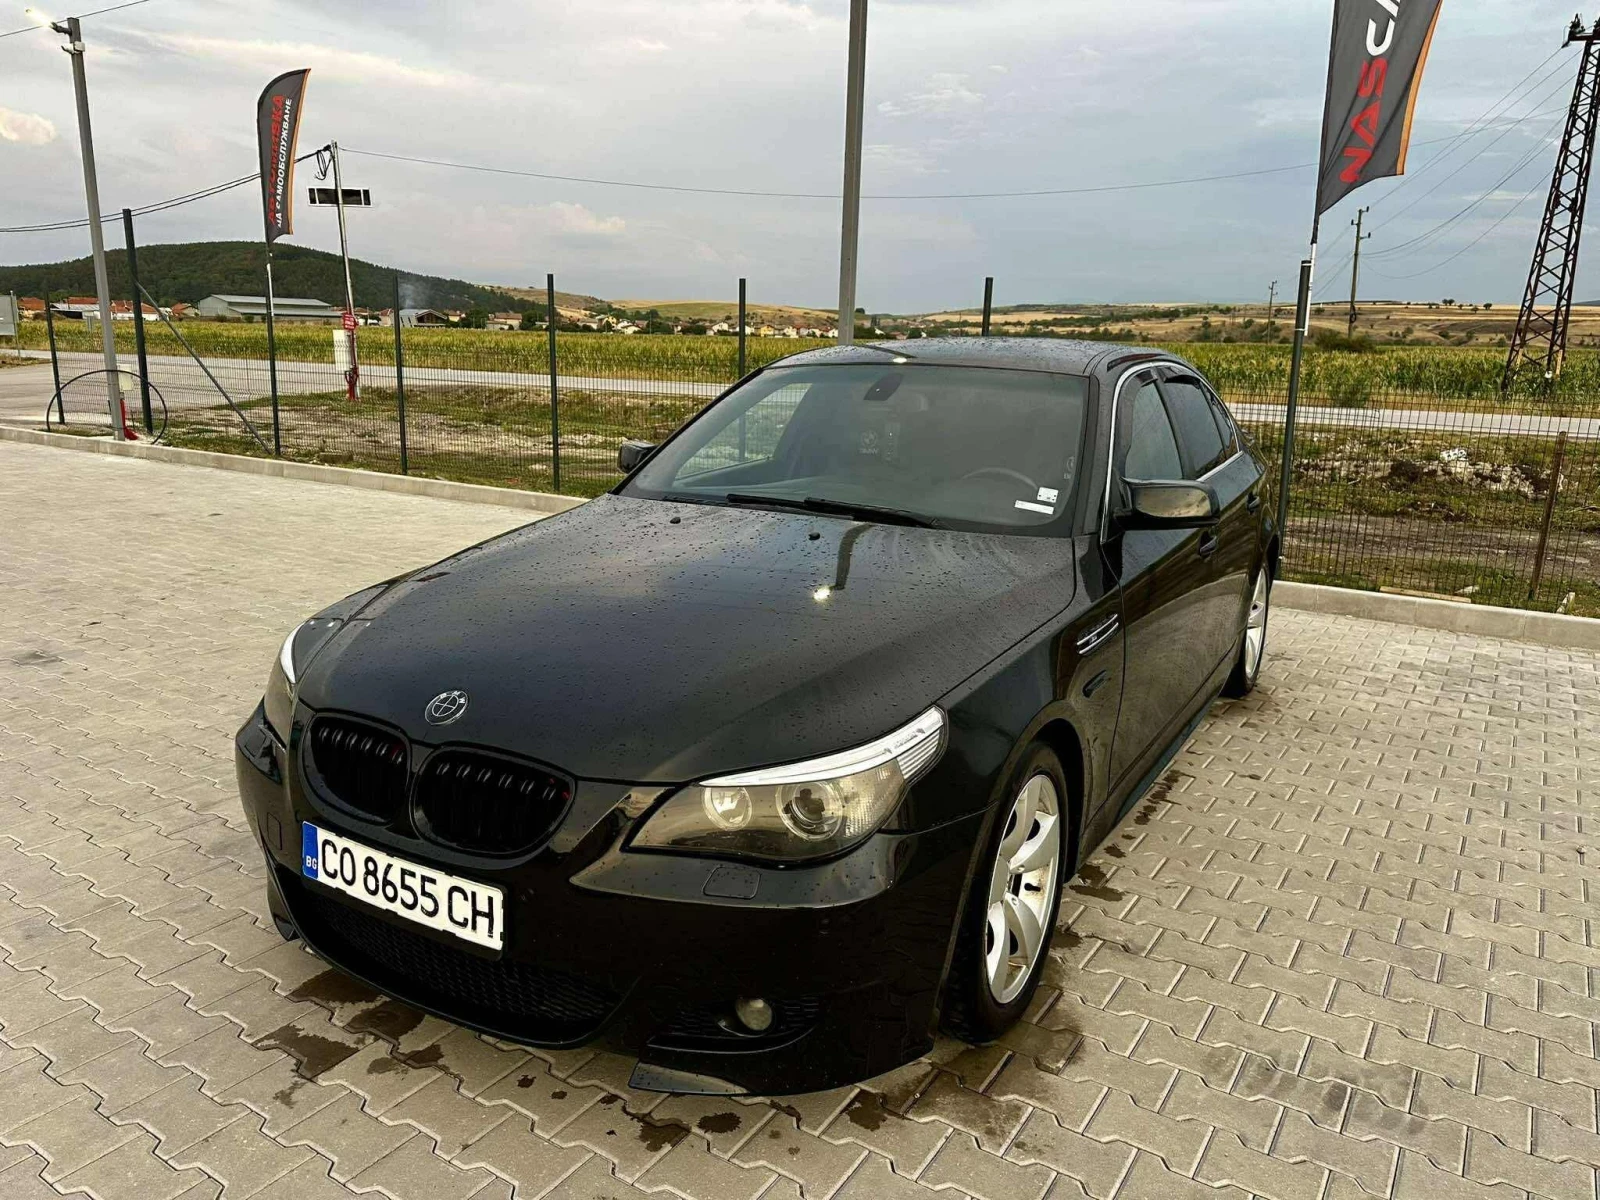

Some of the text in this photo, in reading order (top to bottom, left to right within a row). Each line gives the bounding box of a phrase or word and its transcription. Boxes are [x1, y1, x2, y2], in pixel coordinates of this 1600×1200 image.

[275, 98, 292, 209] САМООБСЛУЖВАНЕ
[306, 856, 317, 870] BG
[364, 856, 439, 918] 8655
[448, 885, 494, 938] CH
